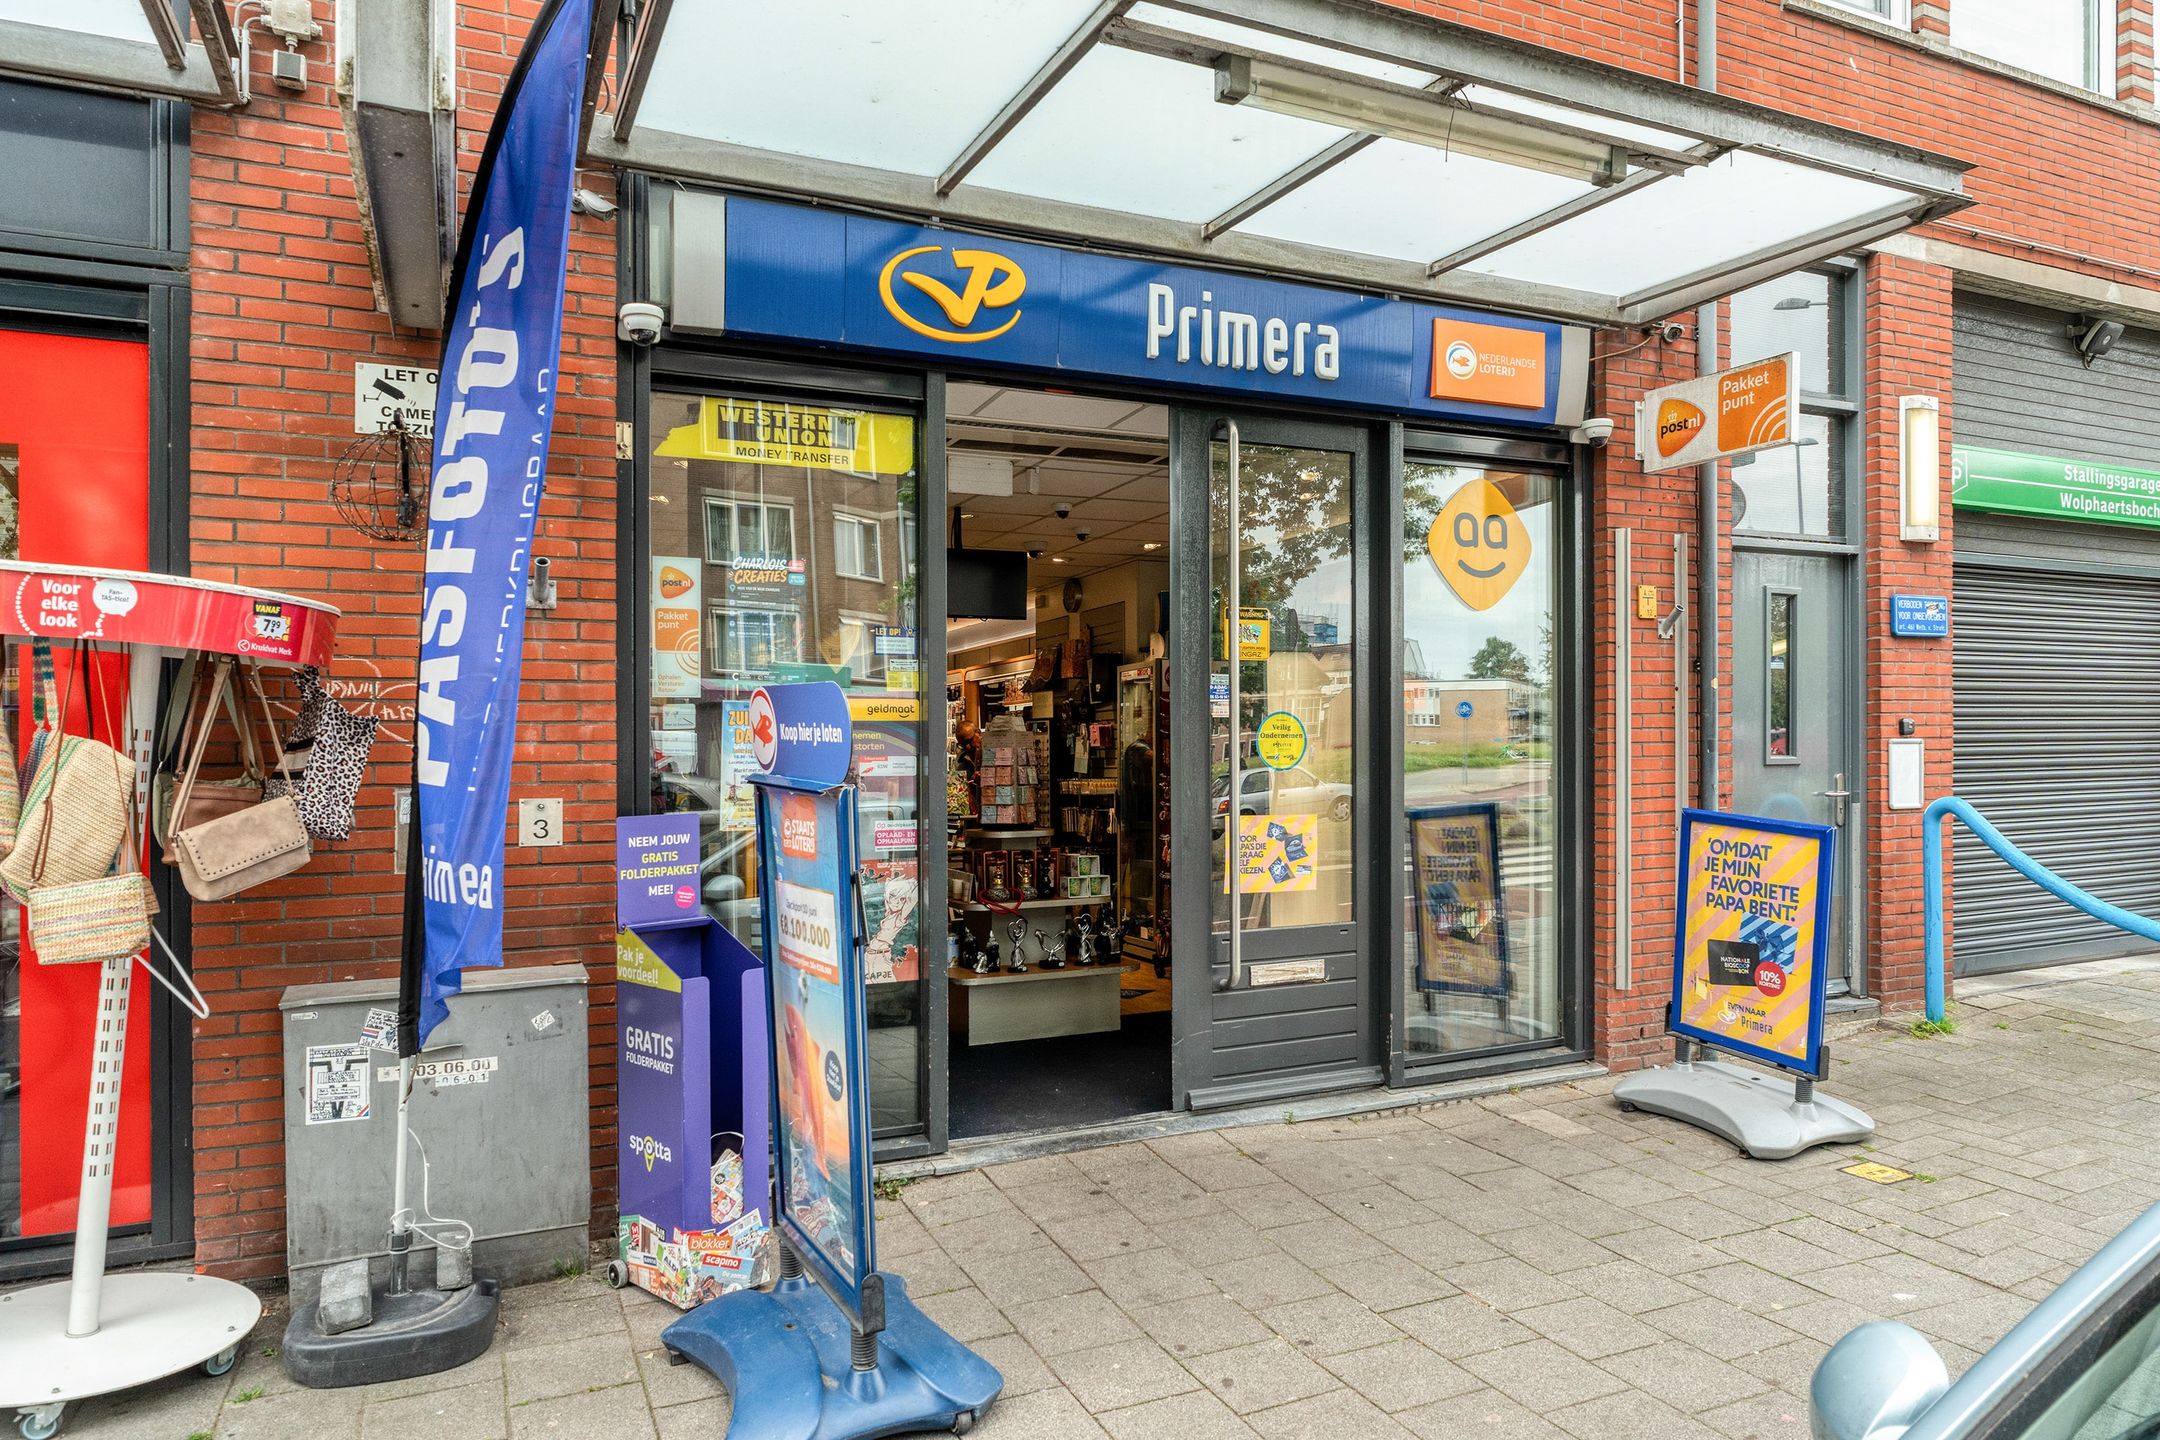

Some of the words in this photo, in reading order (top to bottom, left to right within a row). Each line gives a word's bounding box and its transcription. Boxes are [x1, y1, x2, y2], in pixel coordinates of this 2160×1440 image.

[1146, 282, 1340, 381] Primera
[1479, 352, 1537, 369] NEDERLANDSE
[384, 368, 419, 382] LET
[426, 372, 438, 384] O
[1479, 363, 1516, 377] LOTERIJ
[1722, 371, 1769, 396] Pakket
[1722, 391, 1755, 416] punt
[381, 406, 436, 421] CAME
[719, 406, 833, 431] WESTERN
[1660, 413, 1701, 439] postnl
[756, 425, 833, 447] UNION
[736, 446, 782, 460] MONEY
[787, 451, 849, 465] TRANSFER
[2064, 464, 2160, 494] Stallingsgarage
[732, 557, 787, 571] CHARLOIS
[662, 579, 691, 588] postnl
[734, 569, 787, 584] CREATIES
[42, 579, 81, 595] Voor
[41, 596, 78, 611] elke
[255, 604, 281, 614] VANAF
[40, 611, 78, 628] look
[657, 611, 689, 621] Pakket
[657, 621, 680, 630] punt
[875, 628, 888, 636] LET
[728, 710, 749, 726] ZUI
[867, 704, 915, 716] geldmaat
[735, 728, 753, 744] DA
[780, 723, 797, 745] Koop
[798, 722, 813, 741] hier
[813, 723, 821, 747] je
[821, 722, 843, 743] loten
[852, 732, 881, 740] nemen
[853, 739, 885, 750] storten
[533, 818, 549, 839] 3
[791, 819, 815, 837] STAATS
[876, 831, 906, 839] OPLAAD-
[628, 835, 658, 848] NEEM
[660, 833, 691, 846] JOUW
[876, 837, 916, 845] OPHAALPUNT
[1240, 835, 1257, 843] OOR
[641, 851, 679, 864] GRATIS
[1239, 859, 1250, 867] ELF
[620, 864, 699, 881] FOLDERPAKKET
[1704, 856, 1719, 873] JE
[1721, 859, 1761, 879] MIJN
[648, 884, 674, 897] MEE!
[1710, 875, 1800, 904] FAVORIETE
[1706, 892, 1746, 913] PAPA
[780, 913, 831, 949] €8.100.000
[617, 945, 634, 962] Pak
[634, 948, 645, 968] je
[1720, 956, 1751, 964] NATIONALE
[617, 963, 659, 984] voordeel!
[1759, 969, 1781, 984] 10%
[1759, 980, 1781, 990] KORTING
[1745, 1006, 1766, 1018] NAAR
[1741, 1016, 1773, 1035] Primera
[626, 1026, 674, 1060] GRATIS
[626, 1051, 674, 1075] FOLDERPAKKET
[629, 1134, 672, 1166] spotta
[663, 1256, 679, 1273] ALDI
[705, 1255, 739, 1268] scapino
